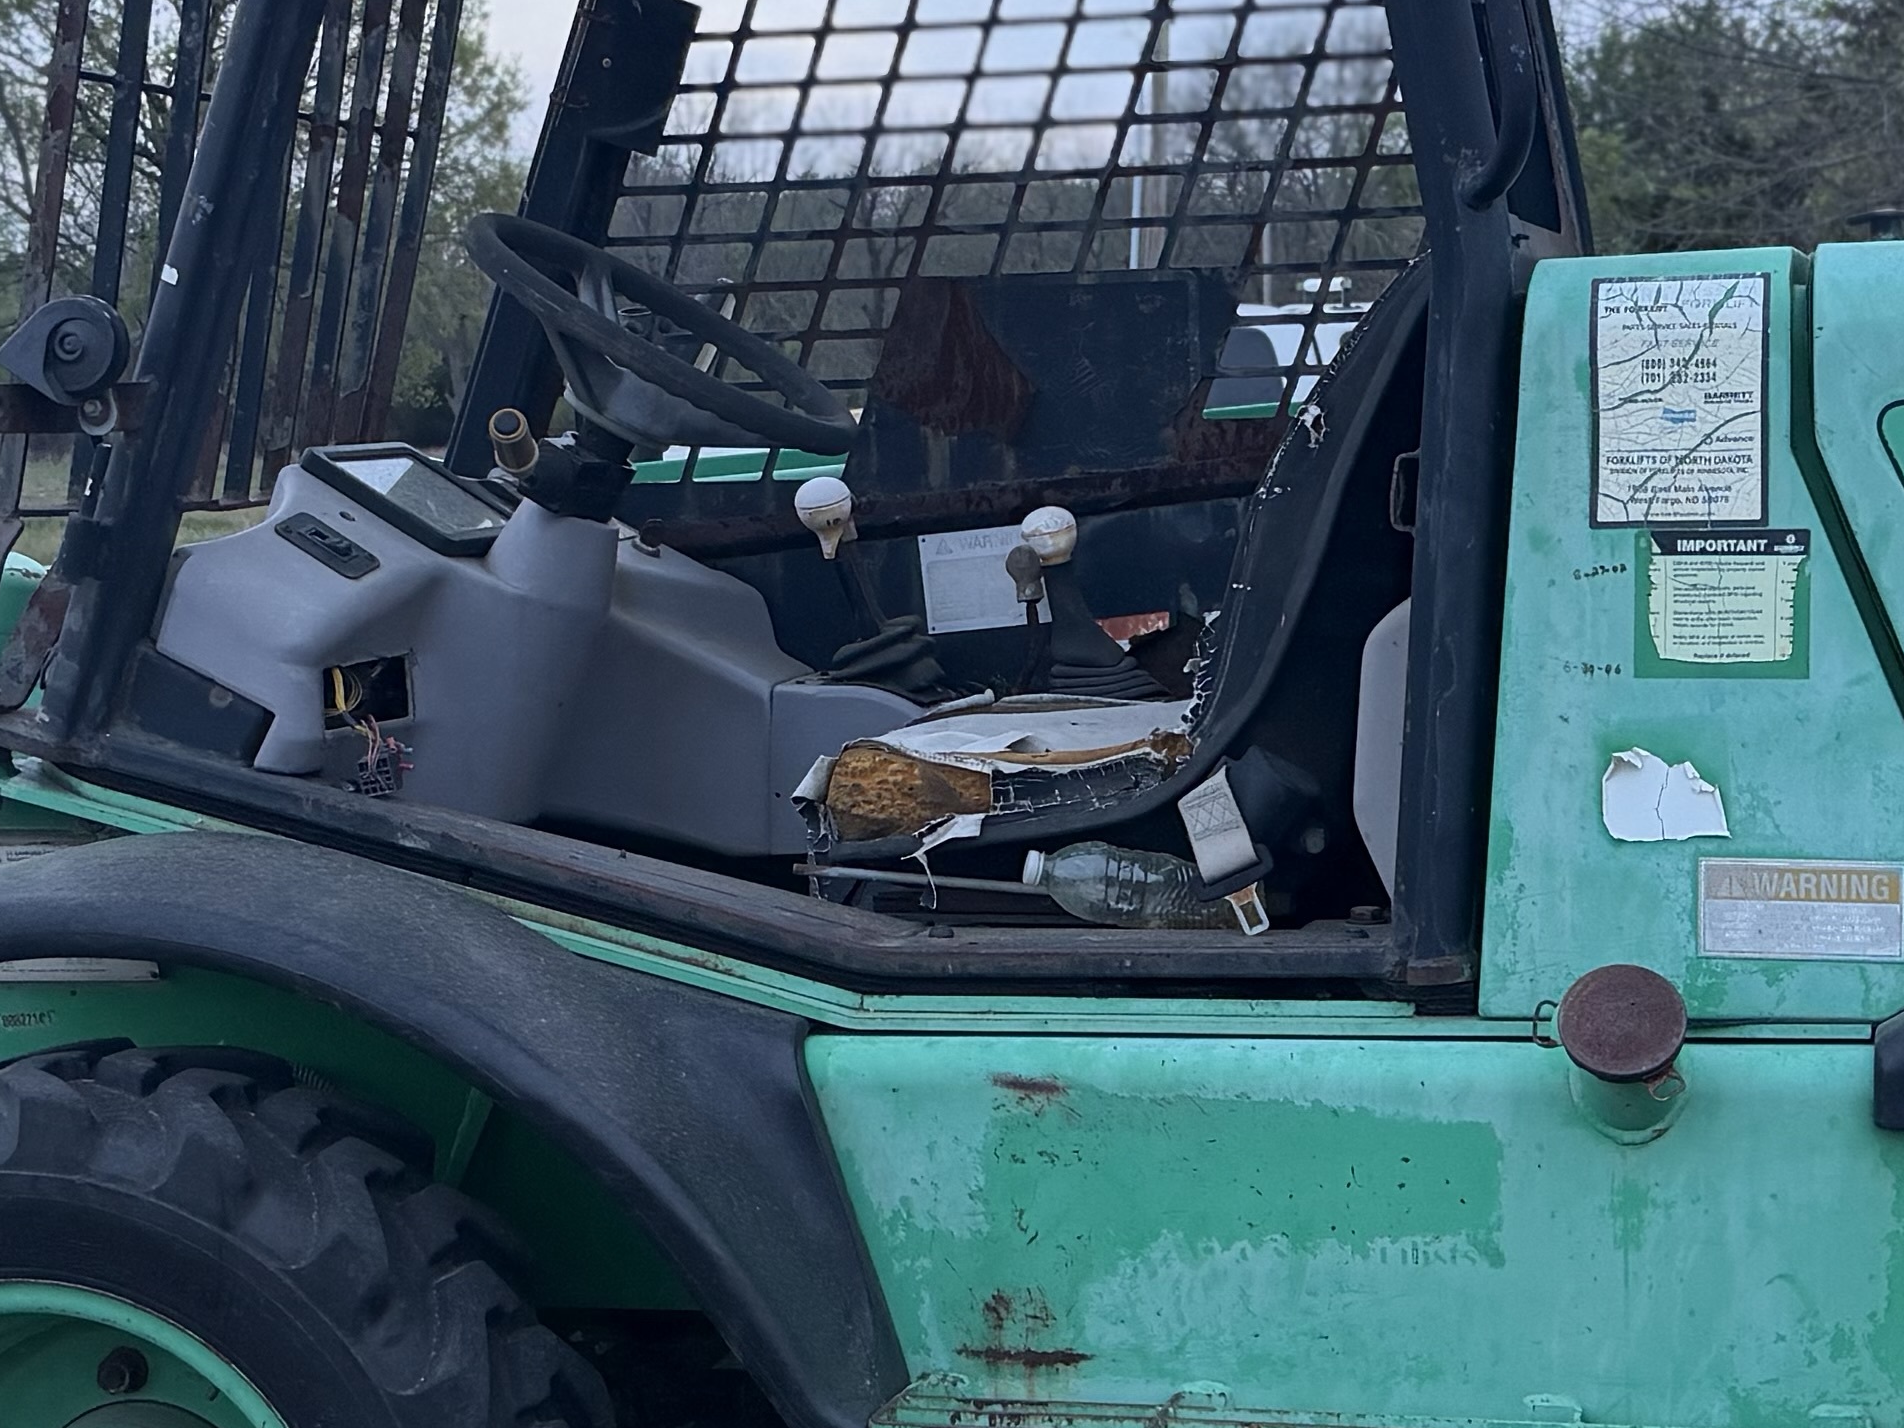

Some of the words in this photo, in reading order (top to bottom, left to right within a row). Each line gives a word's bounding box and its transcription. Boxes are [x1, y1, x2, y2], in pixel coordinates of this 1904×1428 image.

[1606, 455, 1657, 465] FORKLIFTS
[1659, 456, 1672, 465] OF
[1714, 454, 1753, 465] DAKOTA
[1676, 539, 1768, 553] IMPORTANT
[1752, 872, 1890, 900] WARNING
